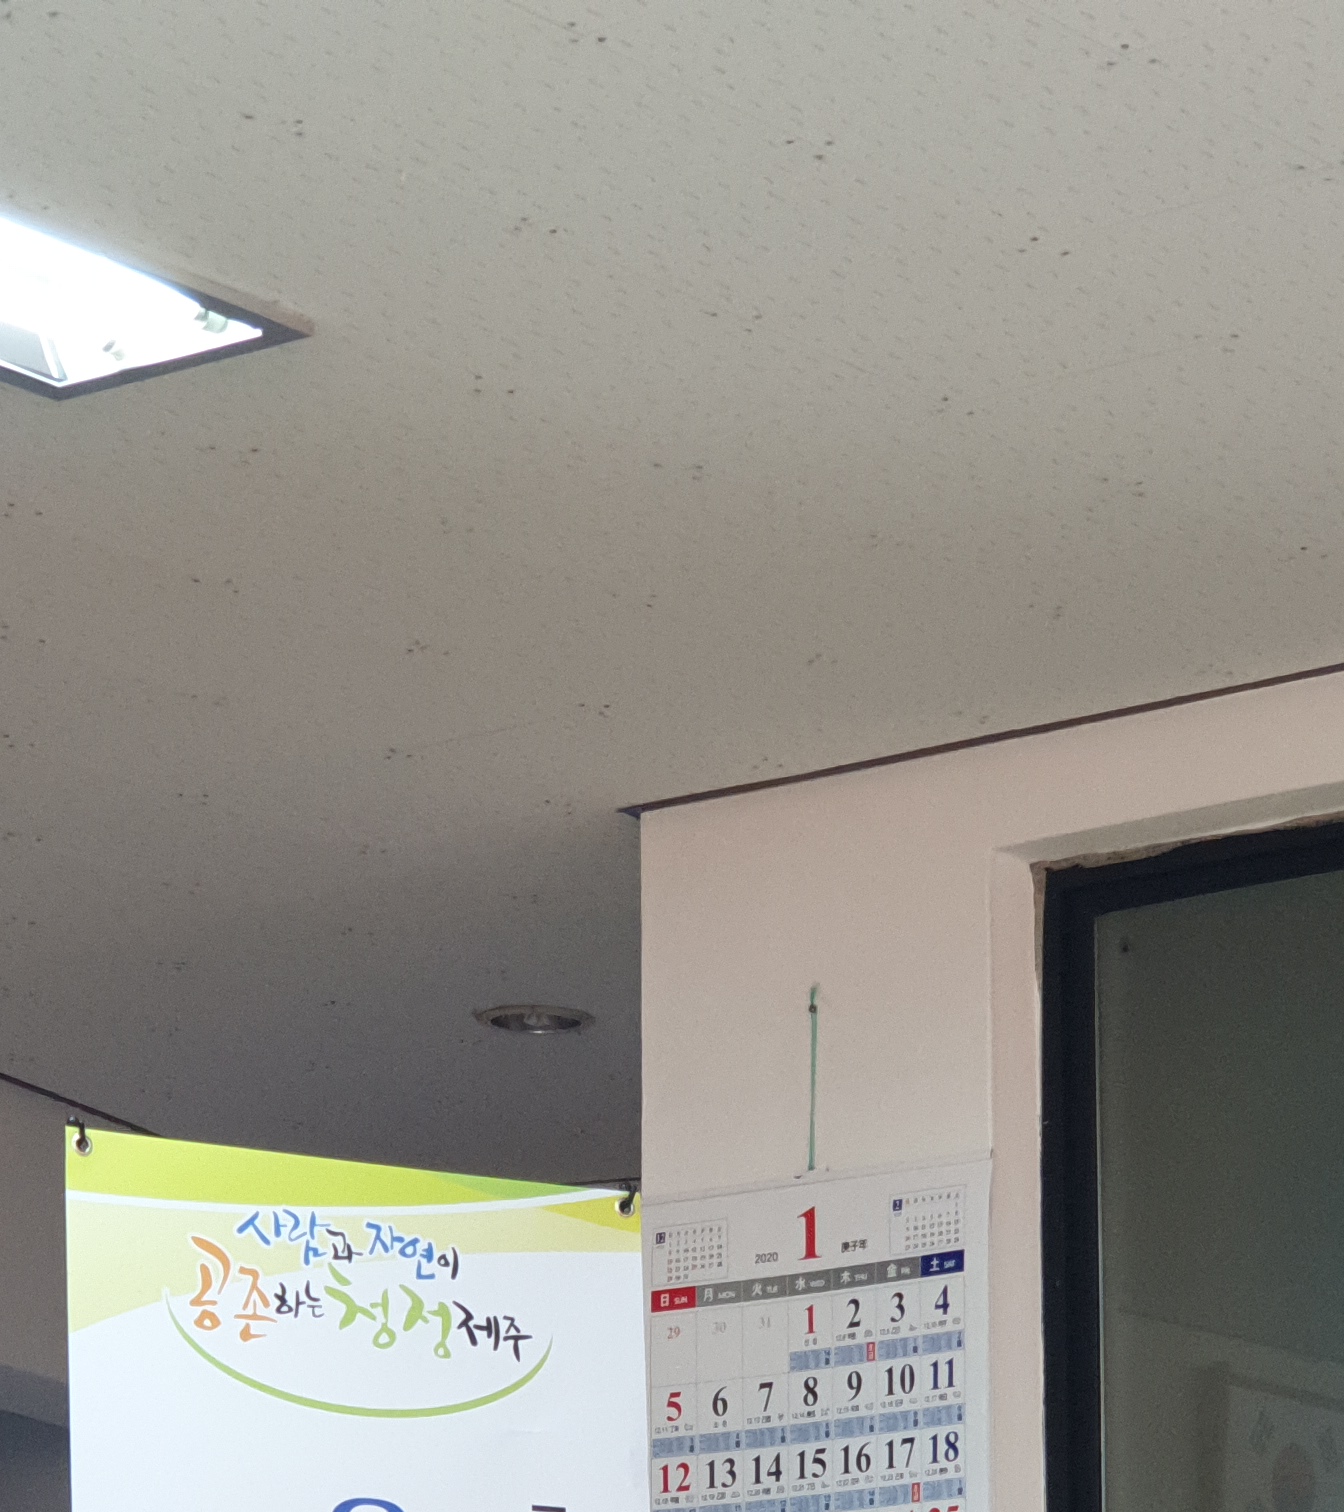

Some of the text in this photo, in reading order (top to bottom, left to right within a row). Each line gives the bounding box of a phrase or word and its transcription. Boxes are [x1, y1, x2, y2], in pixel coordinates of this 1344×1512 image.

[236, 1209, 460, 1281] 사람과 자연이
[755, 1252, 778, 1264] 2020
[797, 1206, 822, 1260] 1
[189, 1235, 327, 1343] 공존하는
[661, 1294, 669, 1307] 日
[704, 1288, 713, 1302] 月
[752, 1282, 762, 1296] 火
[795, 1277, 806, 1291] 水
[840, 1271, 851, 1284] 木
[886, 1263, 897, 1278] 金
[929, 1258, 939, 1271] 土
[667, 1326, 680, 1340] 29
[804, 1305, 815, 1335] 1
[846, 1299, 861, 1329] 2
[890, 1292, 905, 1323] 3
[934, 1285, 950, 1315] 4
[666, 1358, 956, 1422] 5 6 7 8 9 10 11
[658, 1431, 959, 1494] 12 13 14 15 16 17 18
